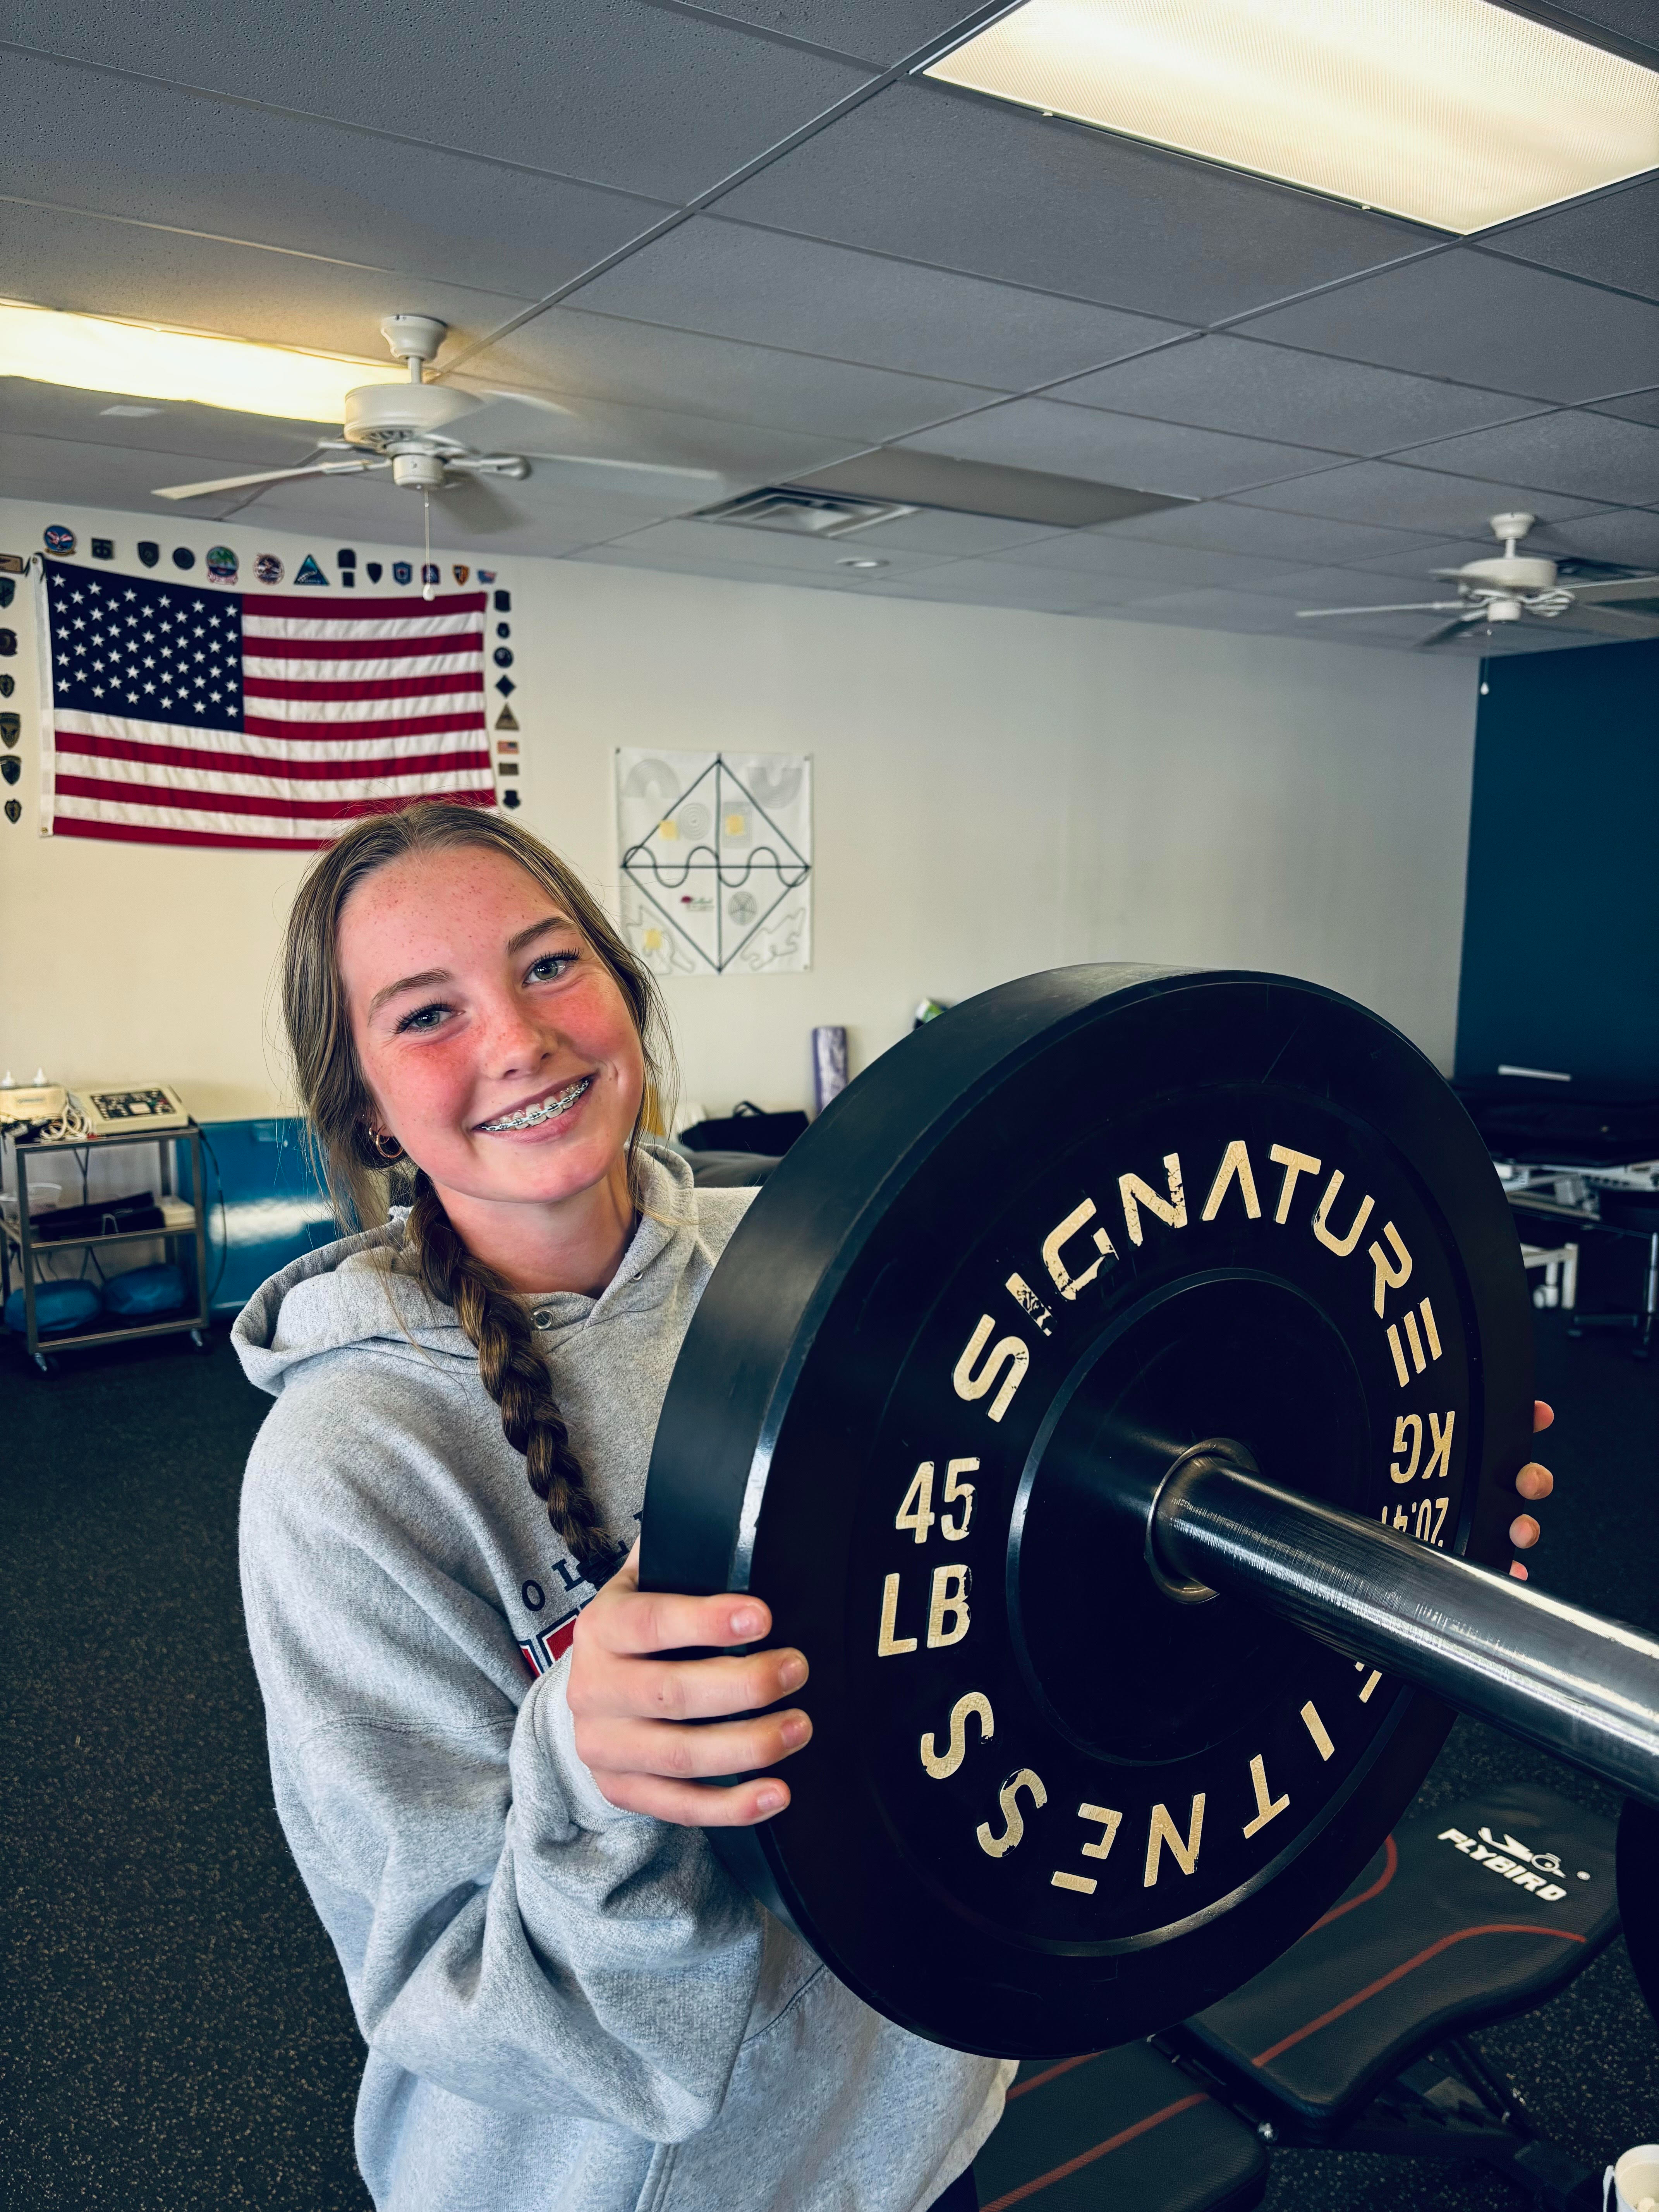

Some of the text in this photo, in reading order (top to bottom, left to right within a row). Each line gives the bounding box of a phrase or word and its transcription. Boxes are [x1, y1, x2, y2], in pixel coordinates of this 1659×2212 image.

[953, 1140, 1443, 1422] SIGNATURE
[1390, 1411, 1455, 1484] KG
[895, 1457, 980, 1544] 45
[877, 1564, 972, 1657] LB
[1437, 1827, 1567, 1901] FLYBIRD
